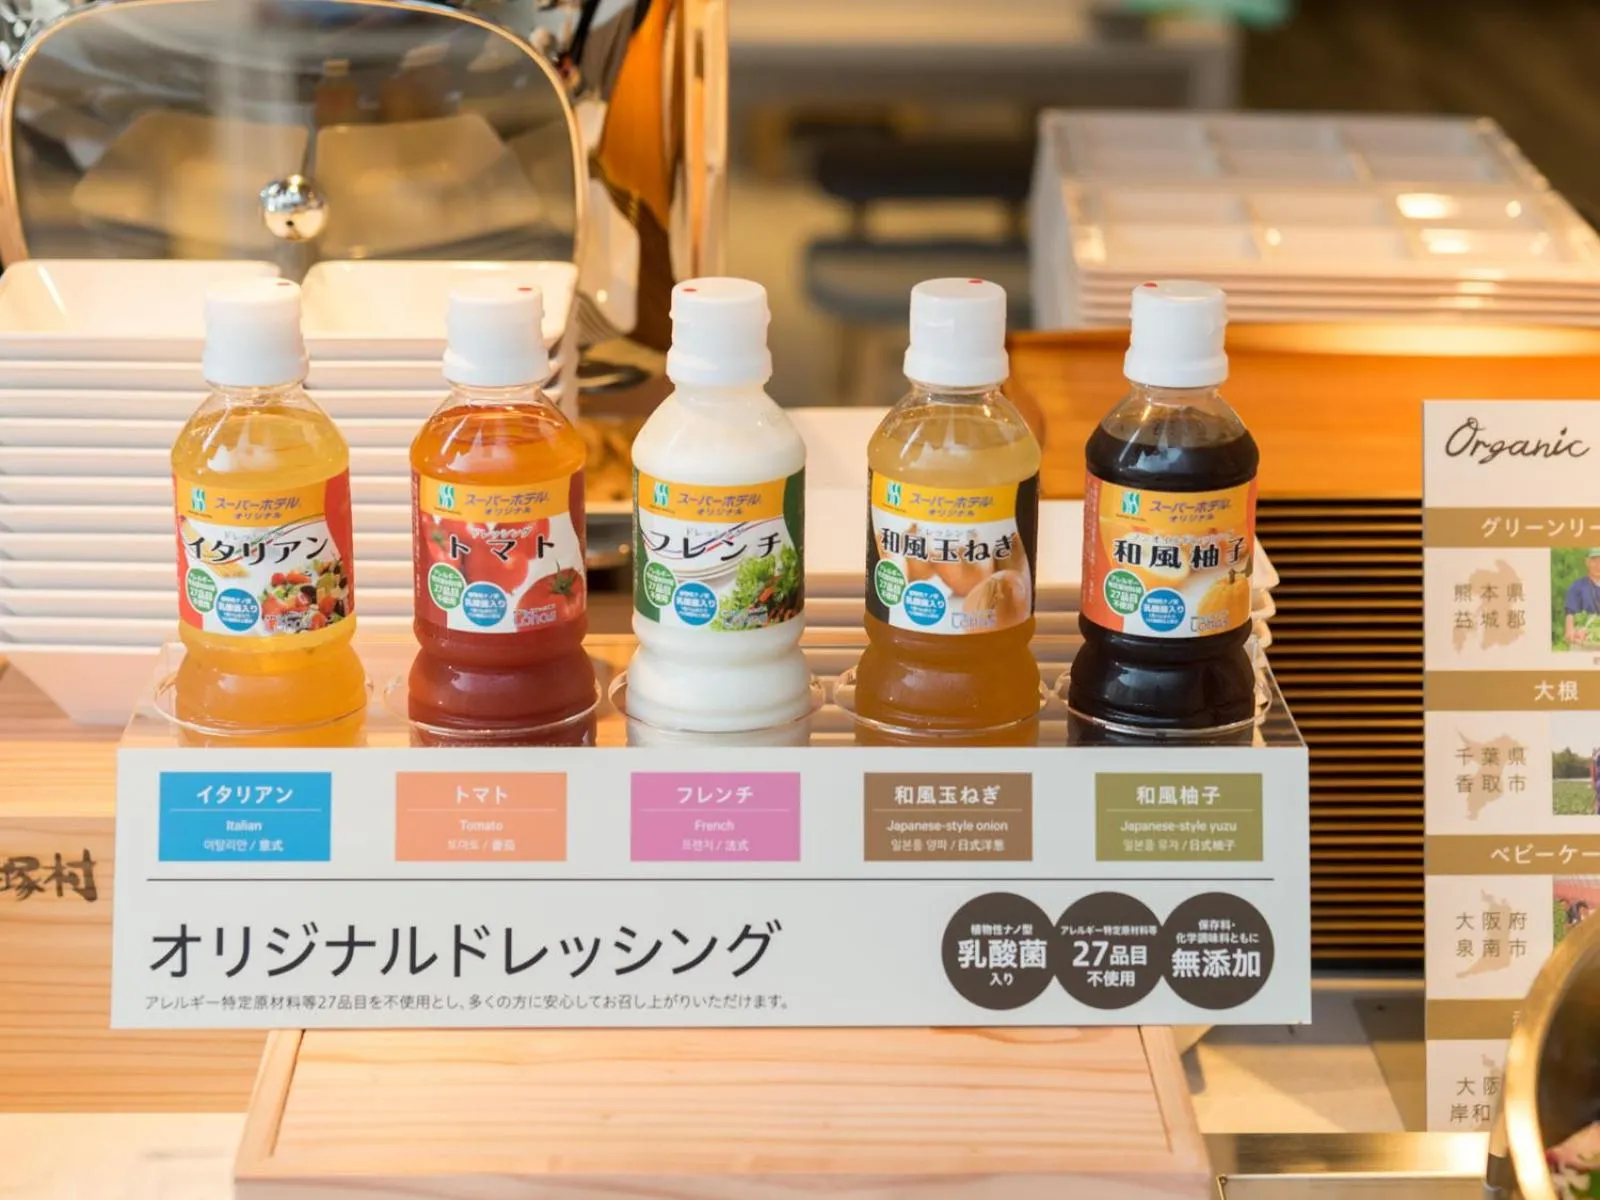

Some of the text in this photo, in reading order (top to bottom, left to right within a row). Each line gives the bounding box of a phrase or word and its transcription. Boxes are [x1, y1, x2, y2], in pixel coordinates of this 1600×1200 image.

[1445, 416, 1590, 465] Organic
[187, 536, 328, 566] イタリアン
[450, 534, 555, 561] トマト
[650, 532, 782, 562] フレンチ
[880, 527, 1016, 563] 和風玉ねぎ
[1113, 536, 1245, 569] 和風柚子
[1454, 583, 1526, 602] 熊本県
[1454, 609, 1526, 630] 益城郡
[1534, 680, 1579, 702] 大根
[1454, 747, 1527, 767] 千葉県
[1454, 774, 1527, 794] 香取市
[196, 785, 294, 805] イタリアン
[456, 785, 508, 805] トマト
[676, 785, 754, 804] フレンチ
[894, 785, 1001, 805] 和風玉ねぎ
[1136, 785, 1221, 805] 和風柚子
[226, 820, 263, 832] Italian
[459, 820, 504, 832] Tomato
[694, 820, 735, 832] French
[886, 820, 1008, 833] Japanese-style onion
[1120, 820, 1238, 833] Japanese-style yuzu
[970, 923, 1033, 936] 植物性ナノ型
[1059, 925, 1158, 937] アレルギー特定原材料等
[1455, 911, 1528, 931] 大阪府
[150, 918, 783, 978] オリジナルドレッシング
[1175, 932, 1260, 944] 化学調味料ともに
[1455, 938, 1528, 958] 泉南市
[957, 938, 1048, 969] 乳酸菌
[1072, 940, 1148, 967] 27品目
[1171, 947, 1261, 978] 無添加
[988, 972, 1014, 986] 入り
[1086, 970, 1136, 987] 不使用
